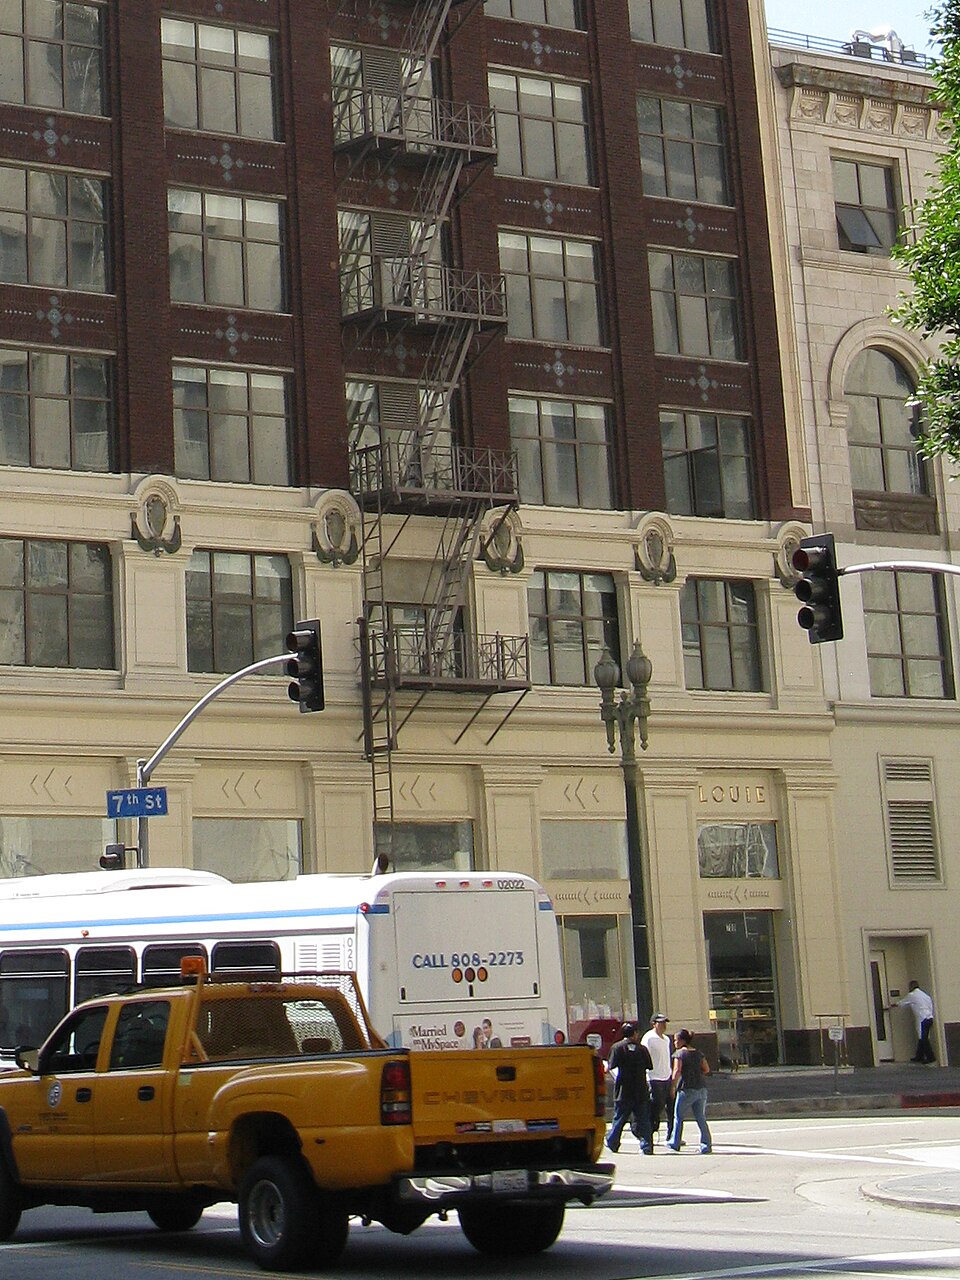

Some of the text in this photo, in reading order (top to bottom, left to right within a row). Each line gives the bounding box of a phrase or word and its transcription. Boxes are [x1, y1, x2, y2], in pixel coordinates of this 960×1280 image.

[698, 785, 765, 803] LOUIE
[112, 794, 162, 813] 7th St
[497, 880, 525, 889] 02022
[412, 951, 524, 969] CALL 808-2273
[421, 1038, 459, 1051] MySpace
[424, 1086, 585, 1105] CHEVROLET
